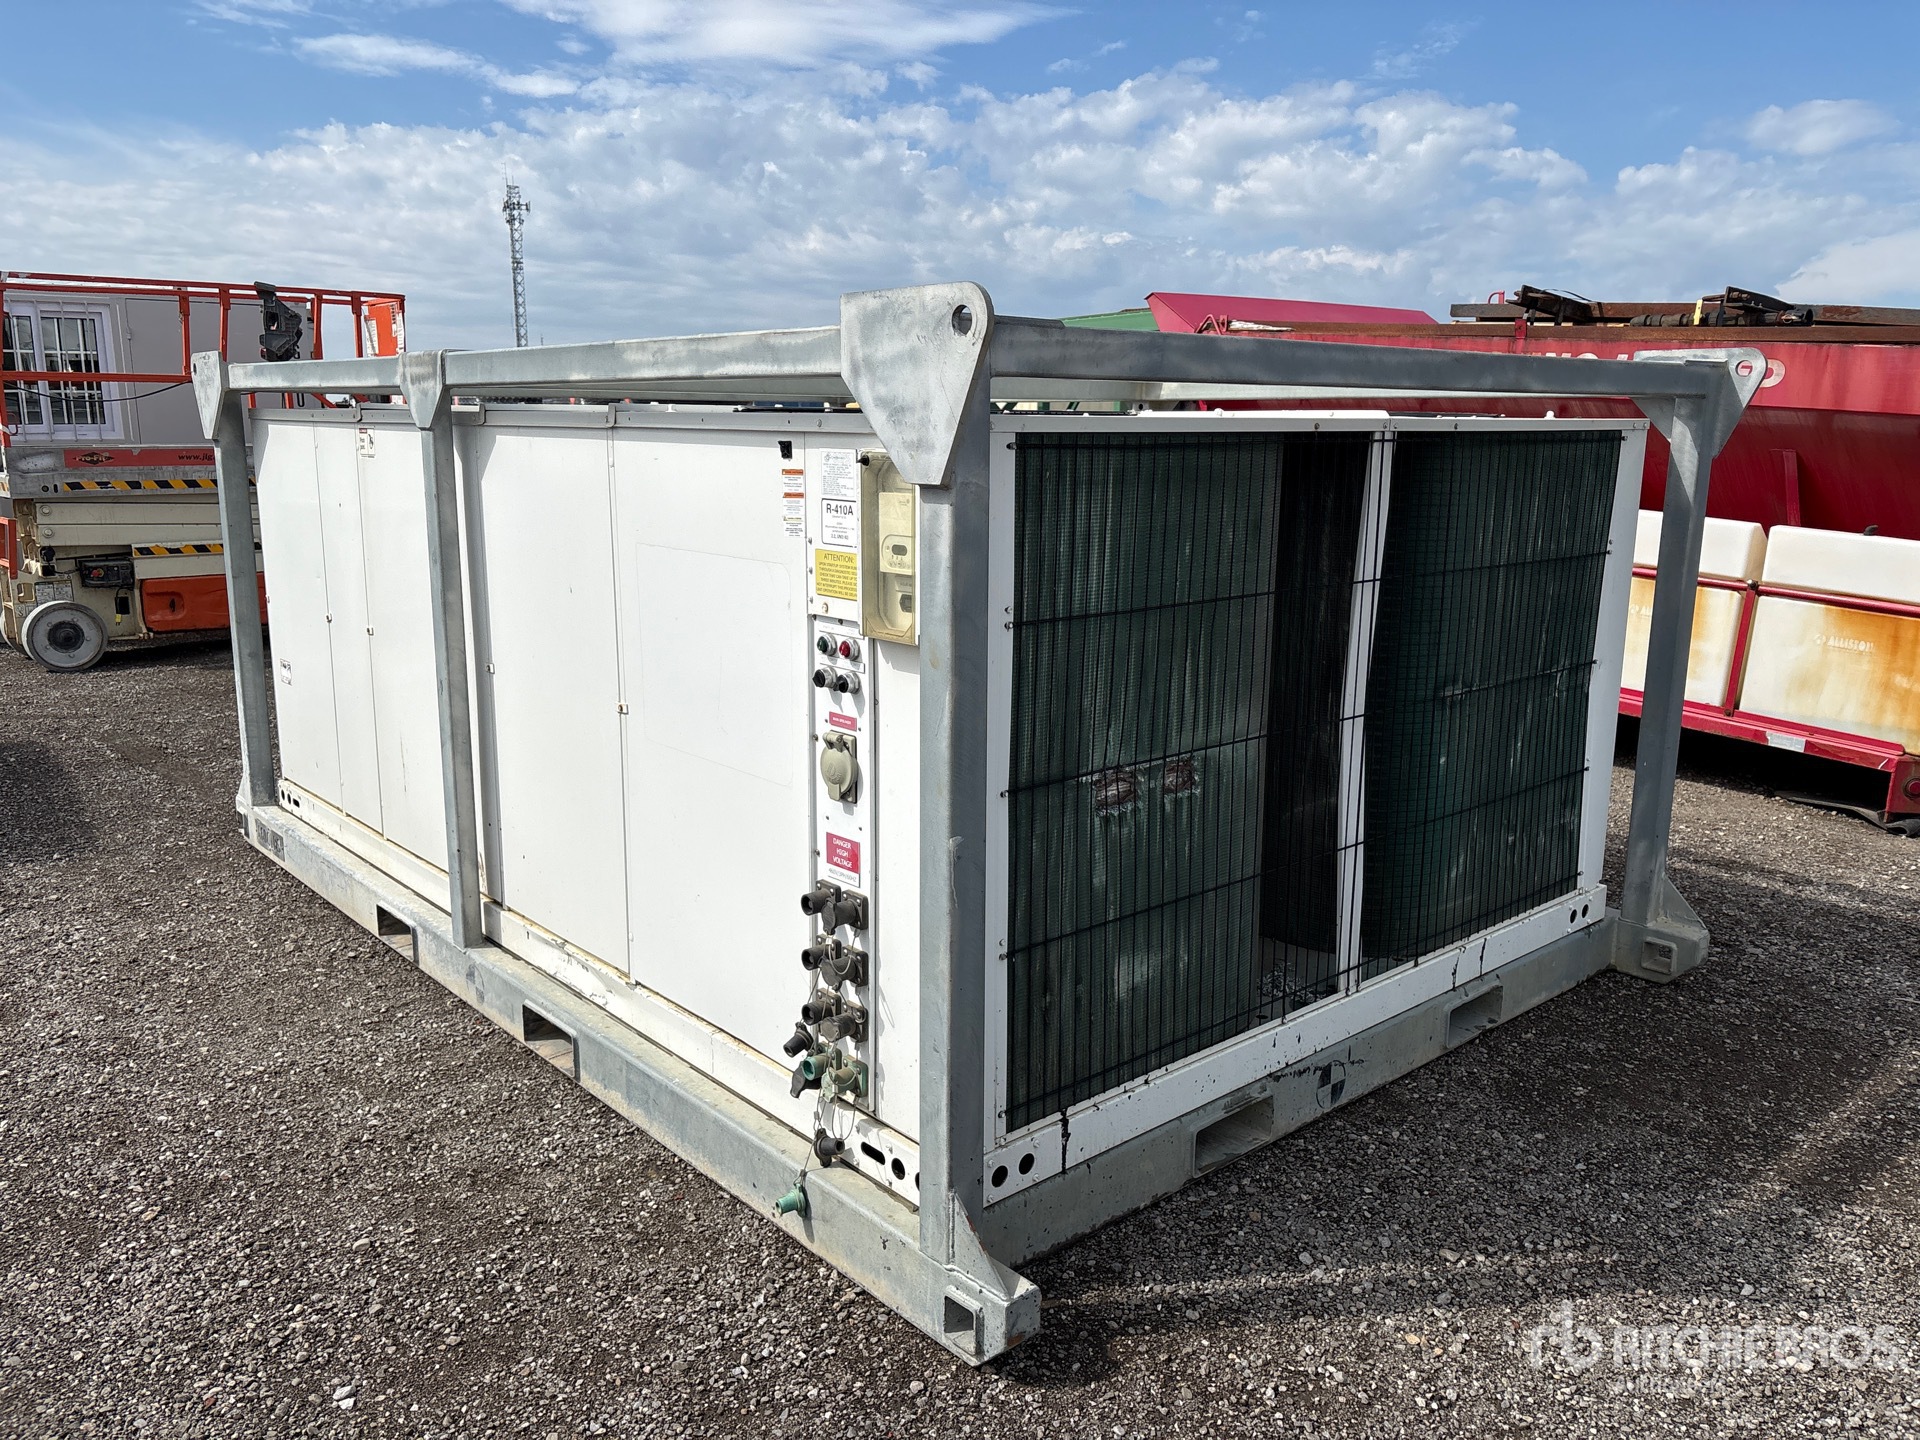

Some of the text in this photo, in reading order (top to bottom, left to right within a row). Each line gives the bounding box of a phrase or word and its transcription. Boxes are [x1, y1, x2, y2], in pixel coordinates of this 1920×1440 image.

[178, 453, 215, 462] www.jlg.
[826, 503, 854, 516] R-410A
[824, 553, 854, 564] ATTENTION:
[832, 838, 851, 849] DANGER
[836, 848, 848, 857] HIGH
[832, 856, 852, 868] VOLTAGE
